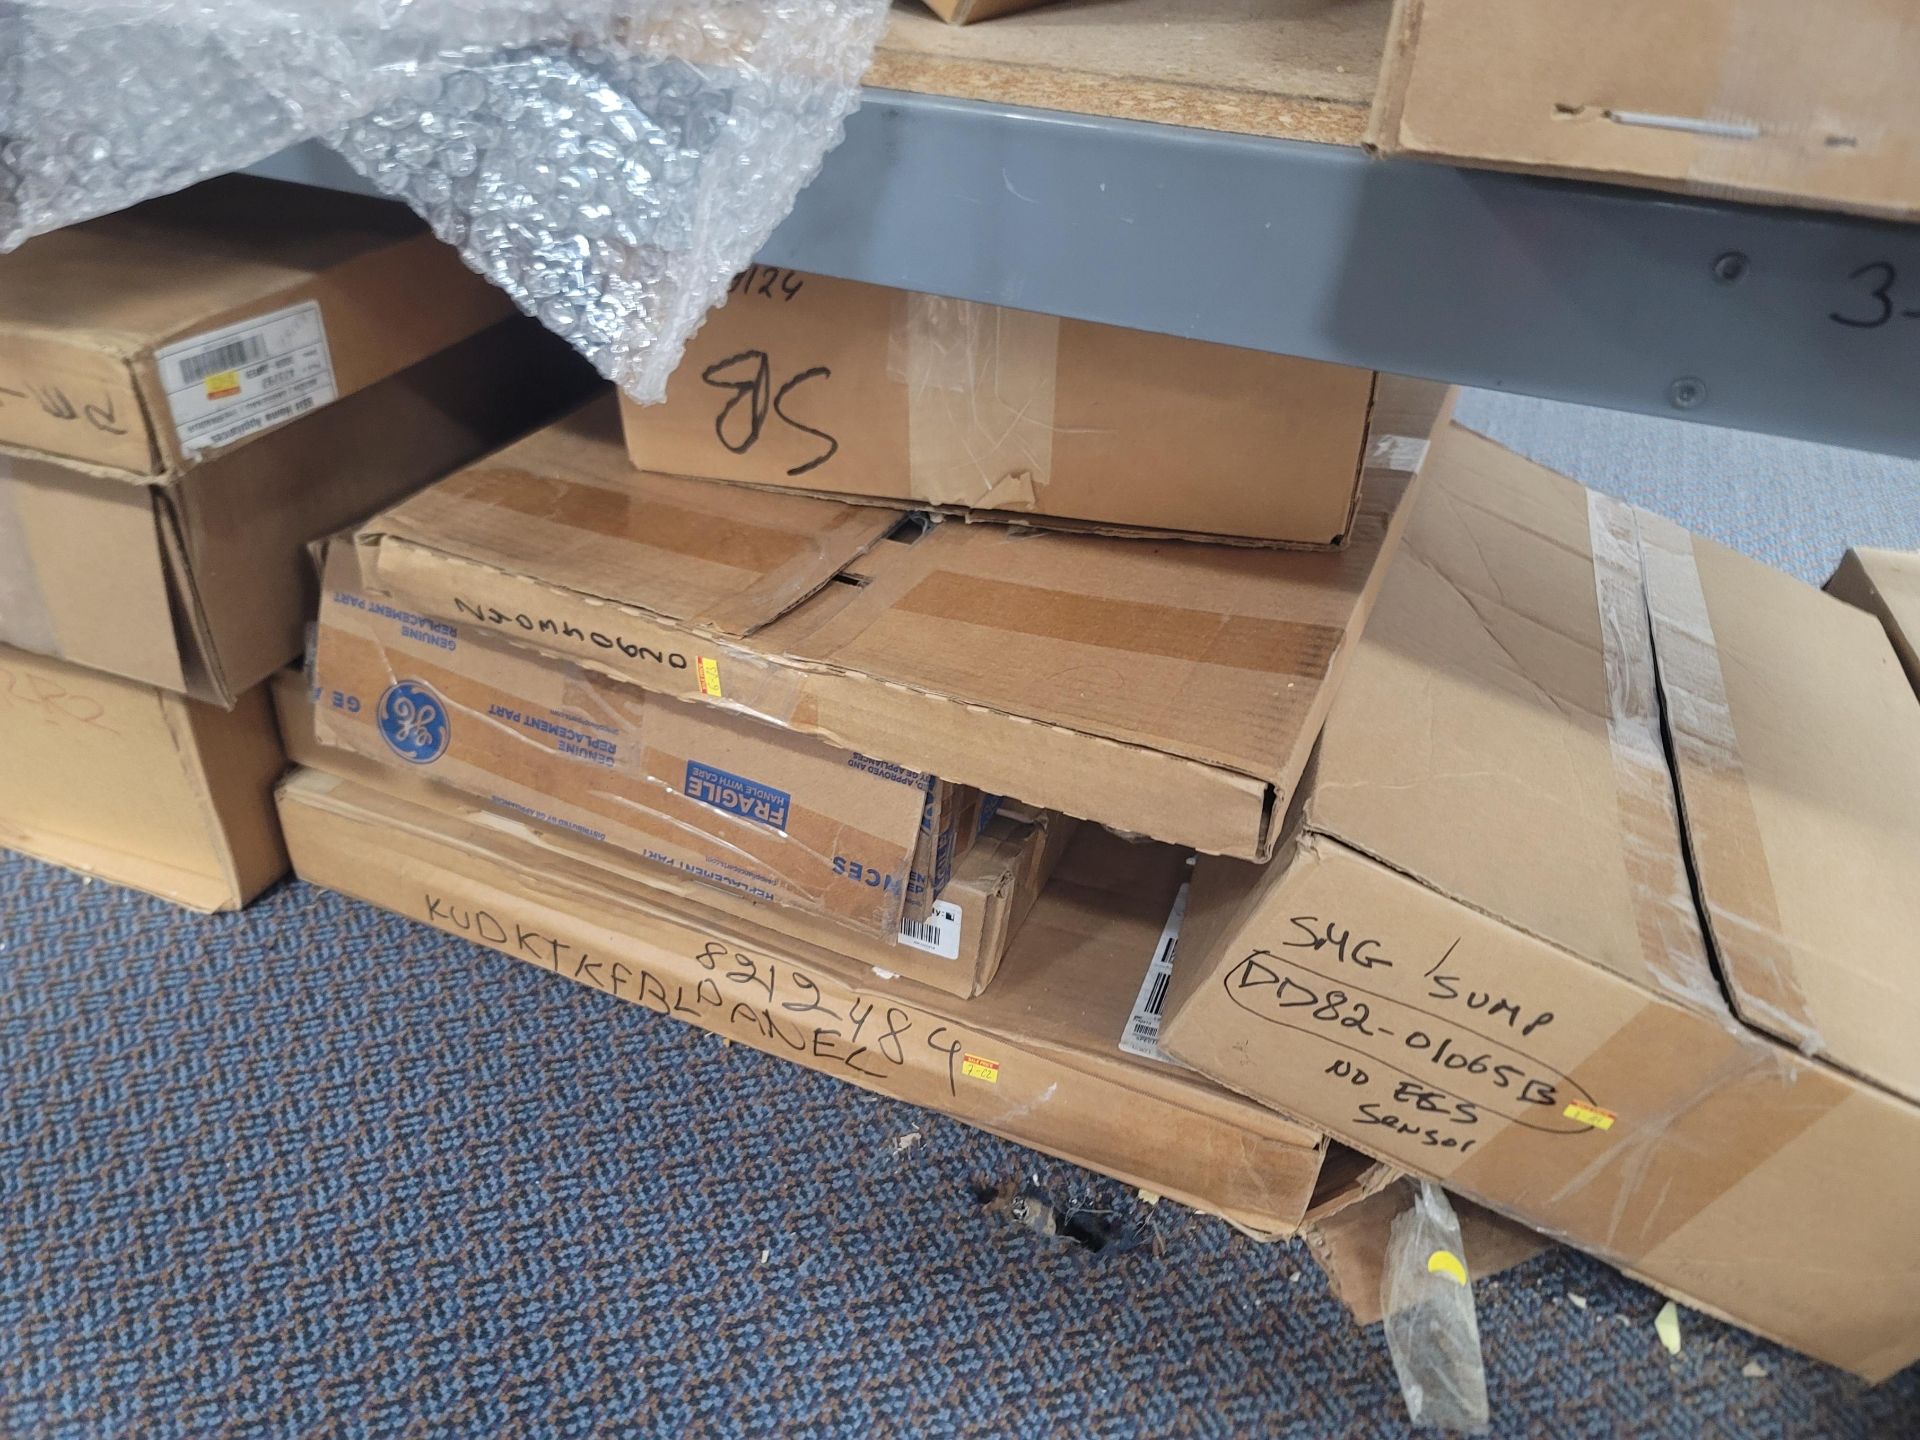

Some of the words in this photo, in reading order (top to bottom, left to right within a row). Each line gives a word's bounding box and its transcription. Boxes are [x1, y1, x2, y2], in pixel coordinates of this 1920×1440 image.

[333, 592, 366, 611] PART
[367, 602, 458, 637] REPLACEMENT
[401, 627, 457, 651] GENUINE
[488, 703, 522, 724] PART
[522, 717, 617, 755] REPLACEMENT
[558, 740, 615, 767] GENUINE
[692, 767, 719, 784] CARE
[847, 759, 867, 776] AND
[866, 763, 914, 788] APPROVED
[718, 775, 745, 793] WITH
[745, 783, 786, 806] HANDLE
[688, 779, 784, 826] FRAGILE
[696, 940, 963, 1098] 8212484
[1238, 959, 1560, 1107] DD82-01065B
